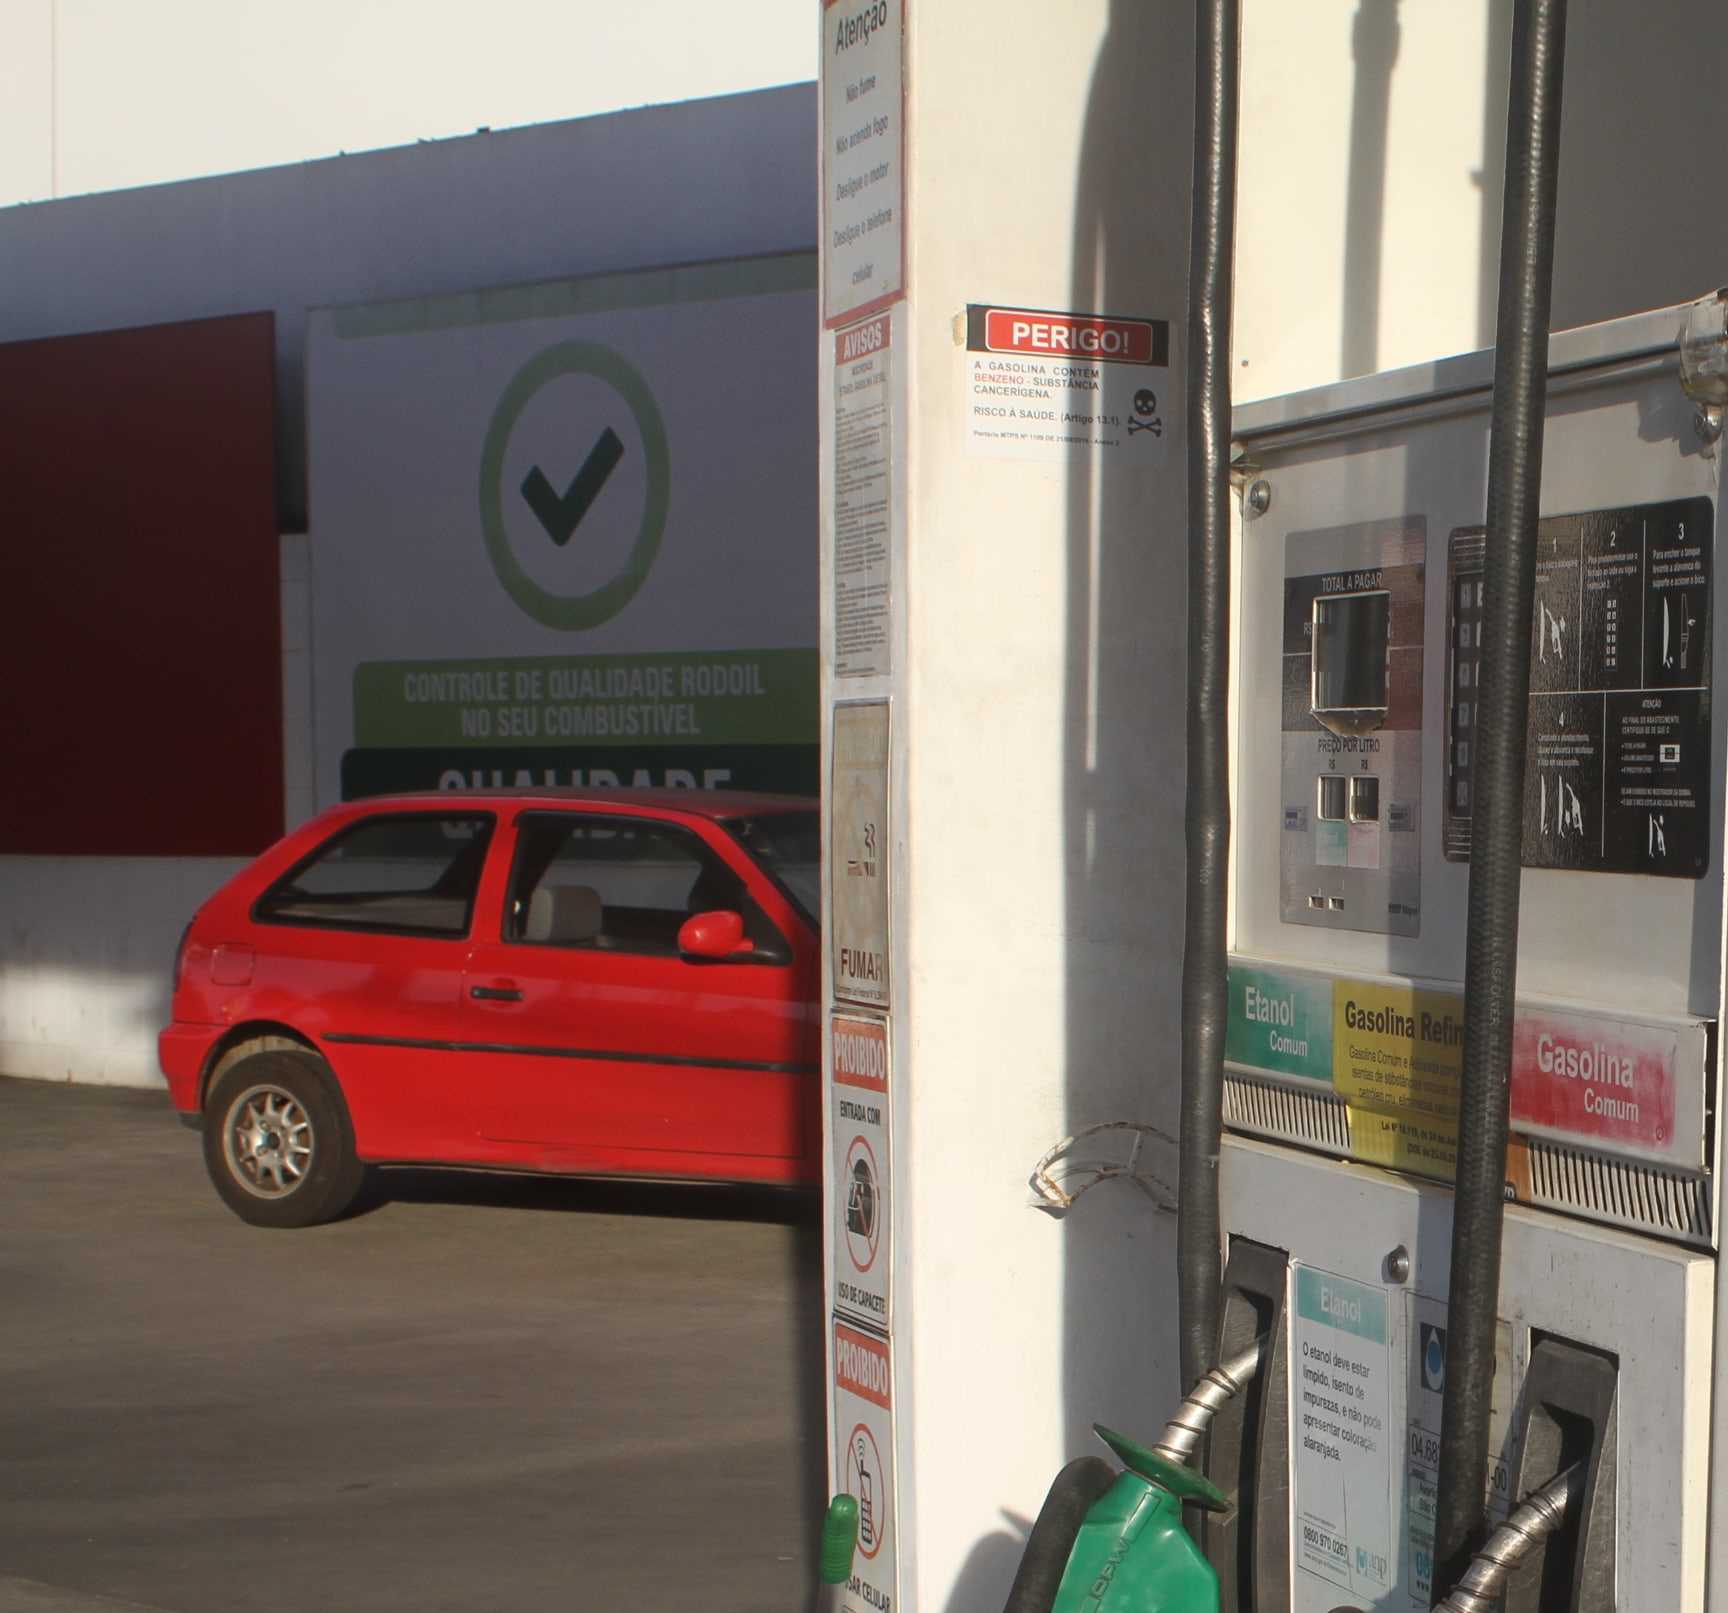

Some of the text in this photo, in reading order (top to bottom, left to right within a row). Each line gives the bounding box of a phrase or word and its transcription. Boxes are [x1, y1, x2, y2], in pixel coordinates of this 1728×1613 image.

[835, 0, 887, 54] Atenção
[843, 321, 882, 360] AVISOS
[1012, 321, 1129, 355] PERIGO!
[974, 361, 1100, 379] A GASOLINA CONTÉM
[974, 373, 1025, 385] BENZENO
[1033, 375, 1100, 391] SUBSTÂNCIA
[974, 405, 1006, 417] RISCO
[1060, 412, 1094, 425] (Artigo
[1609, 530, 1616, 547] 2
[1678, 522, 1685, 540] 3
[1321, 572, 1384, 593] TOTAL A PAGAR
[404, 662, 766, 703] CONTROLE DE QUALIDADE RODOIL
[461, 698, 701, 738] NO SEU COMBUSTÍVEL
[1318, 737, 1380, 755] PREÇO POR LITRO
[841, 947, 883, 983] FUMAR
[1244, 985, 1295, 1027] Etanol
[1345, 1000, 1415, 1039] Gasolina
[835, 1031, 886, 1081] PROIBIDO
[1269, 1030, 1308, 1057] Comum
[1537, 1032, 1637, 1088] Gasolina
[840, 1100, 881, 1126] ENTRADA COM
[1583, 1088, 1640, 1122] Comum
[858, 1291, 886, 1314] CAPACETE
[1320, 1286, 1361, 1322] Etanol
[837, 1338, 888, 1396] PROIBIDO
[1302, 1341, 1370, 1378] O etanol deve estar
[1303, 1413, 1340, 1439] apresentar
